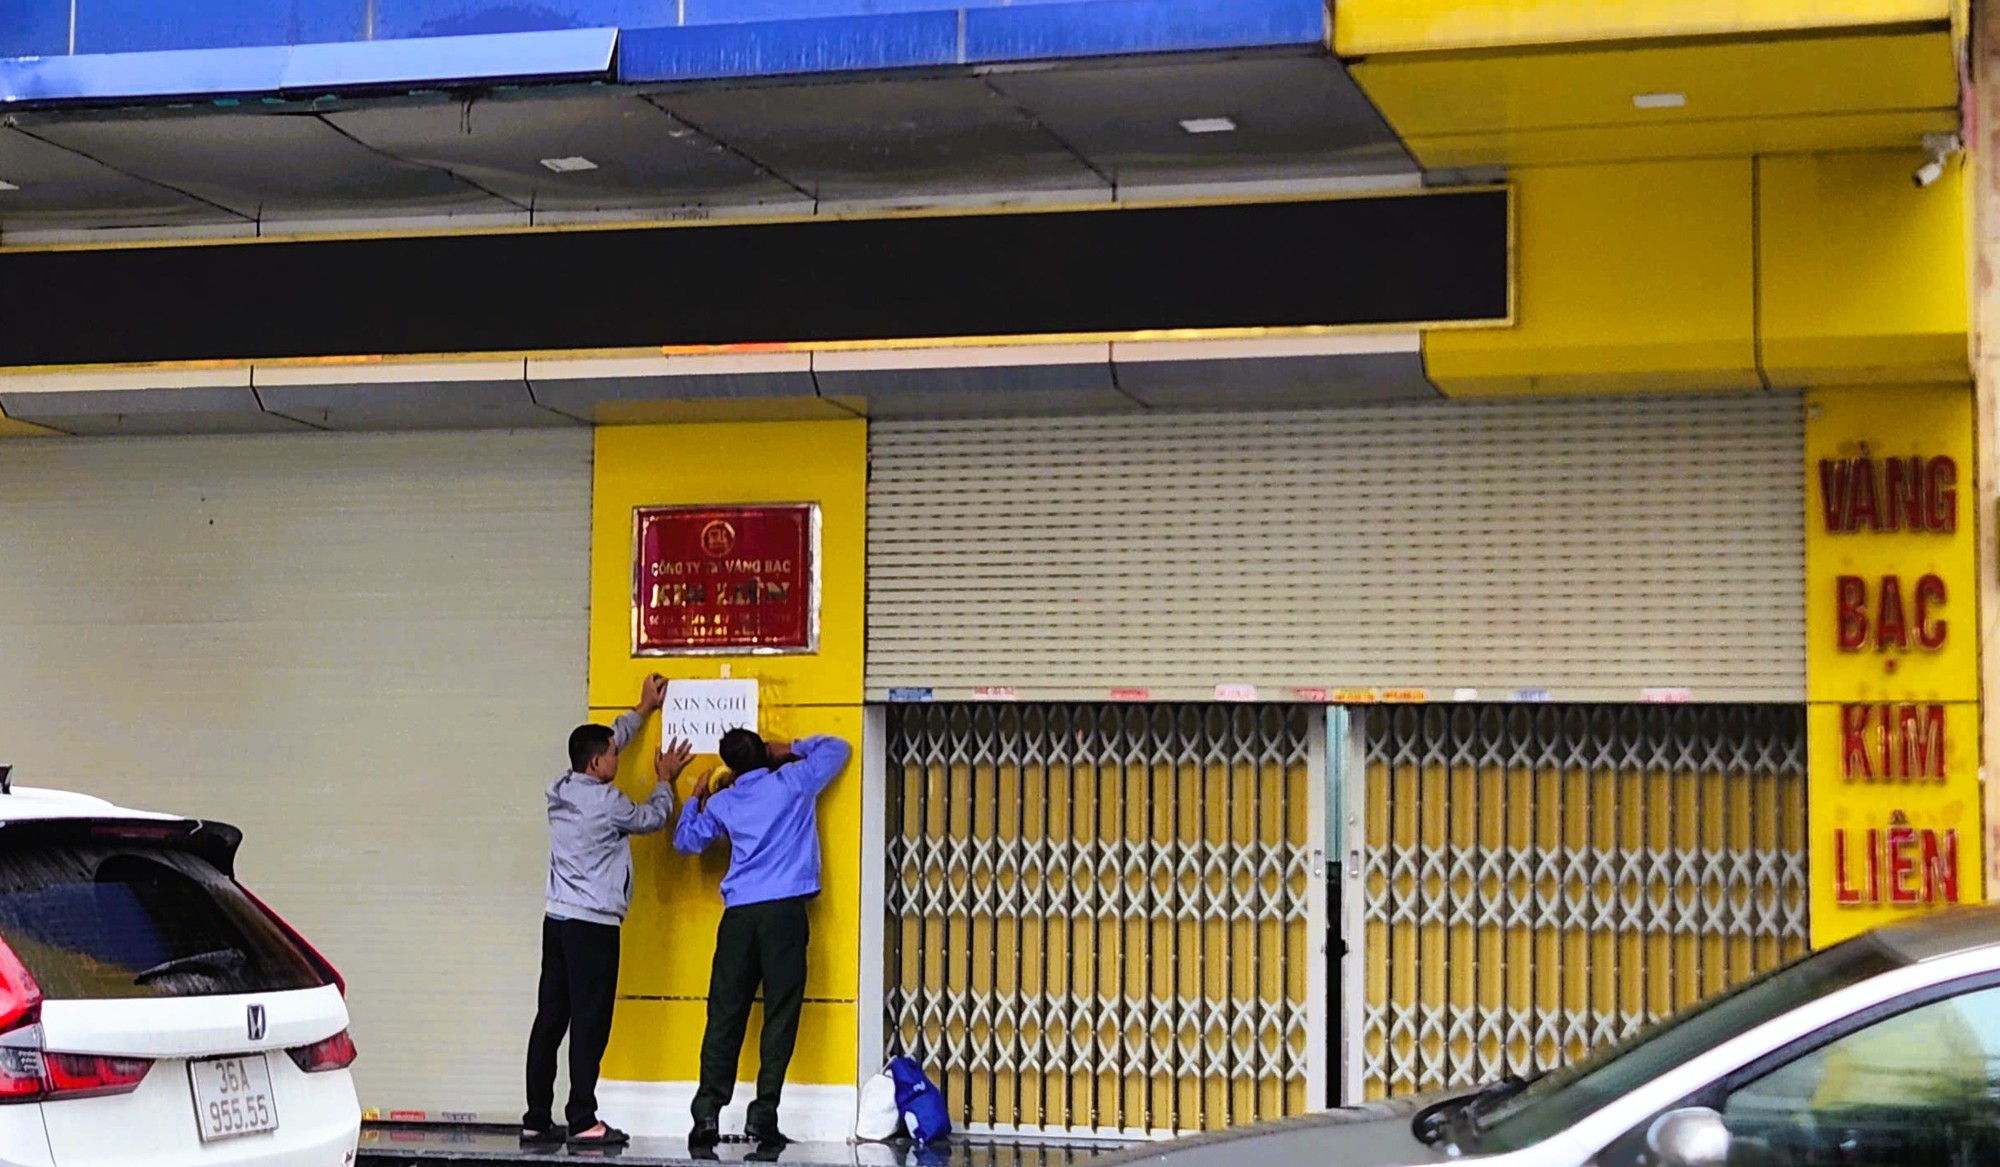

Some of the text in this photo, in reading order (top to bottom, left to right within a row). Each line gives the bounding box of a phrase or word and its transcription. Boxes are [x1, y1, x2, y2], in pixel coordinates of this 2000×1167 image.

[1818, 440, 1957, 535] VÀNG
[686, 561, 701, 574] TY
[725, 558, 762, 573] VÀNG
[765, 560, 791, 577] BẠC
[1834, 573, 1948, 674] BẠC
[672, 696, 700, 711] XIN
[668, 718, 700, 735] BÁN
[1840, 704, 1947, 782] KIM
[1832, 809, 1959, 905] LIÊN
[215, 1059, 250, 1093] 36A
[209, 1094, 270, 1133] 955.55
